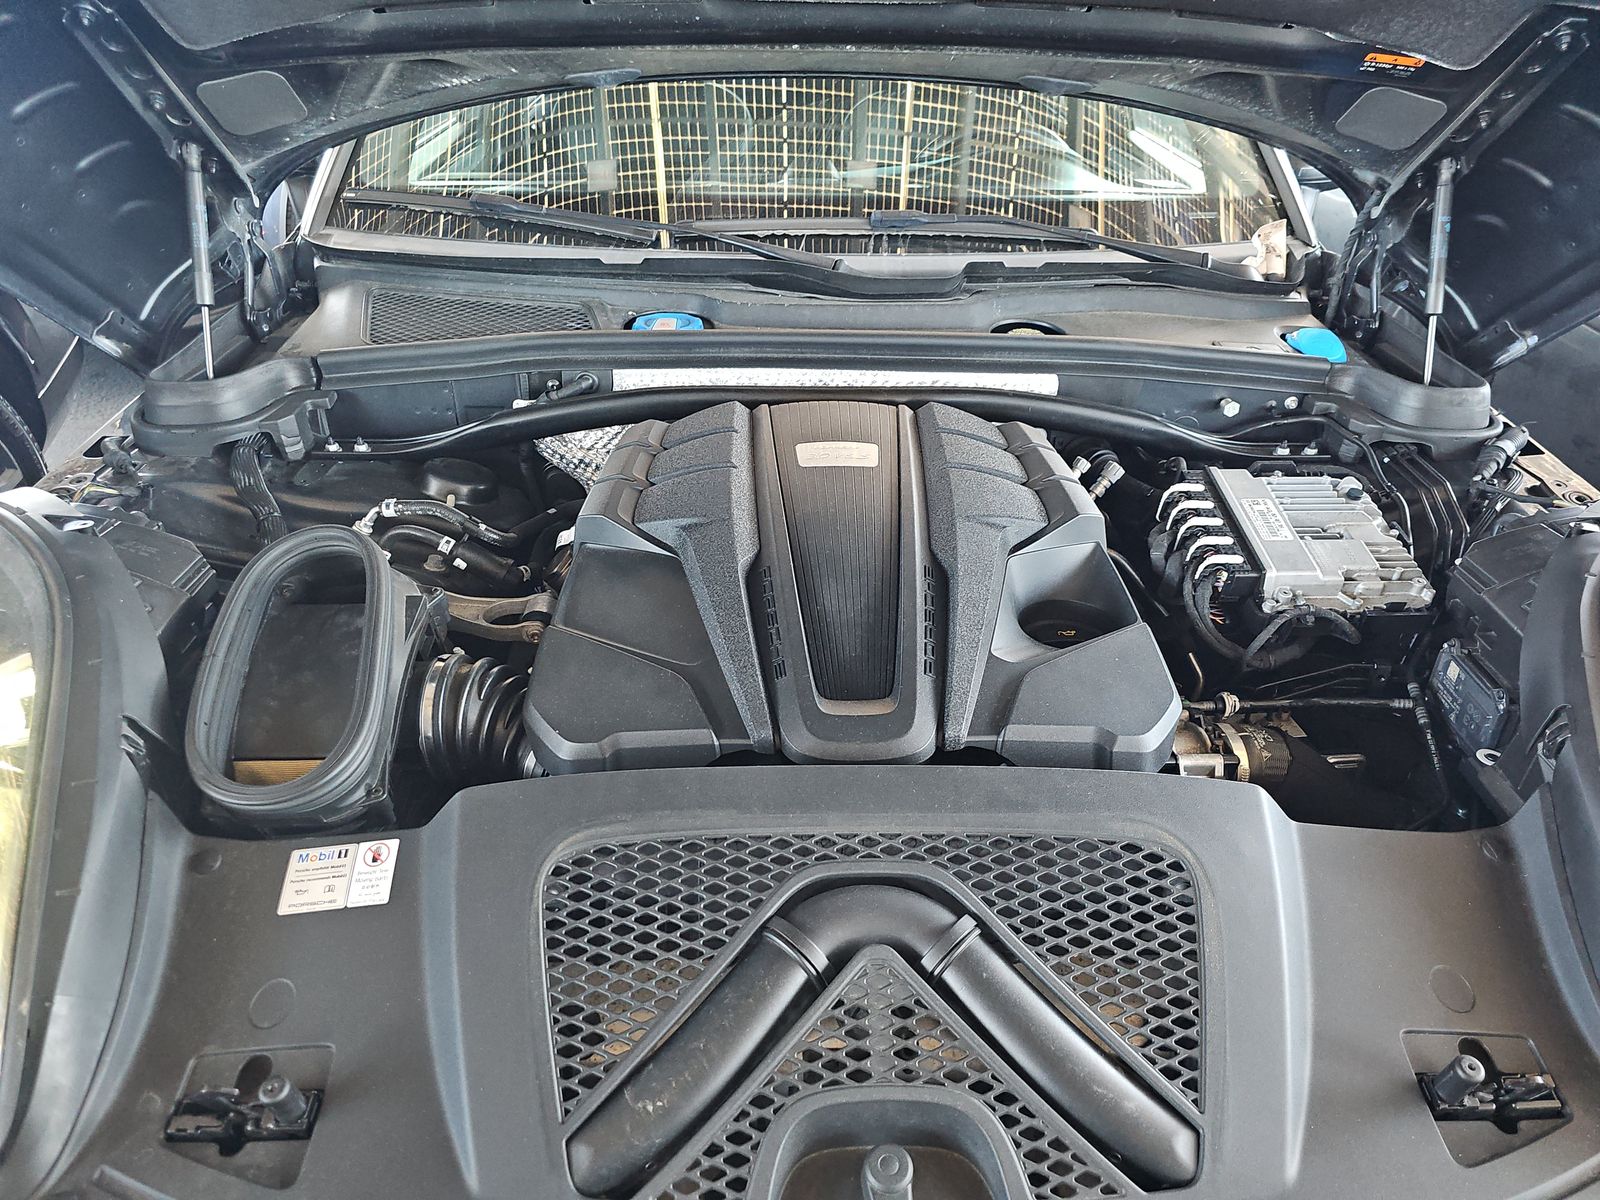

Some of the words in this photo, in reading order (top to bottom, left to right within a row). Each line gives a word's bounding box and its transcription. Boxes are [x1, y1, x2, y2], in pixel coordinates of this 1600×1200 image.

[759, 565, 787, 681] PORSCHE
[922, 564, 937, 679] PORSCHE
[297, 850, 335, 864] Mobil
[288, 898, 337, 908] PORSCHE
